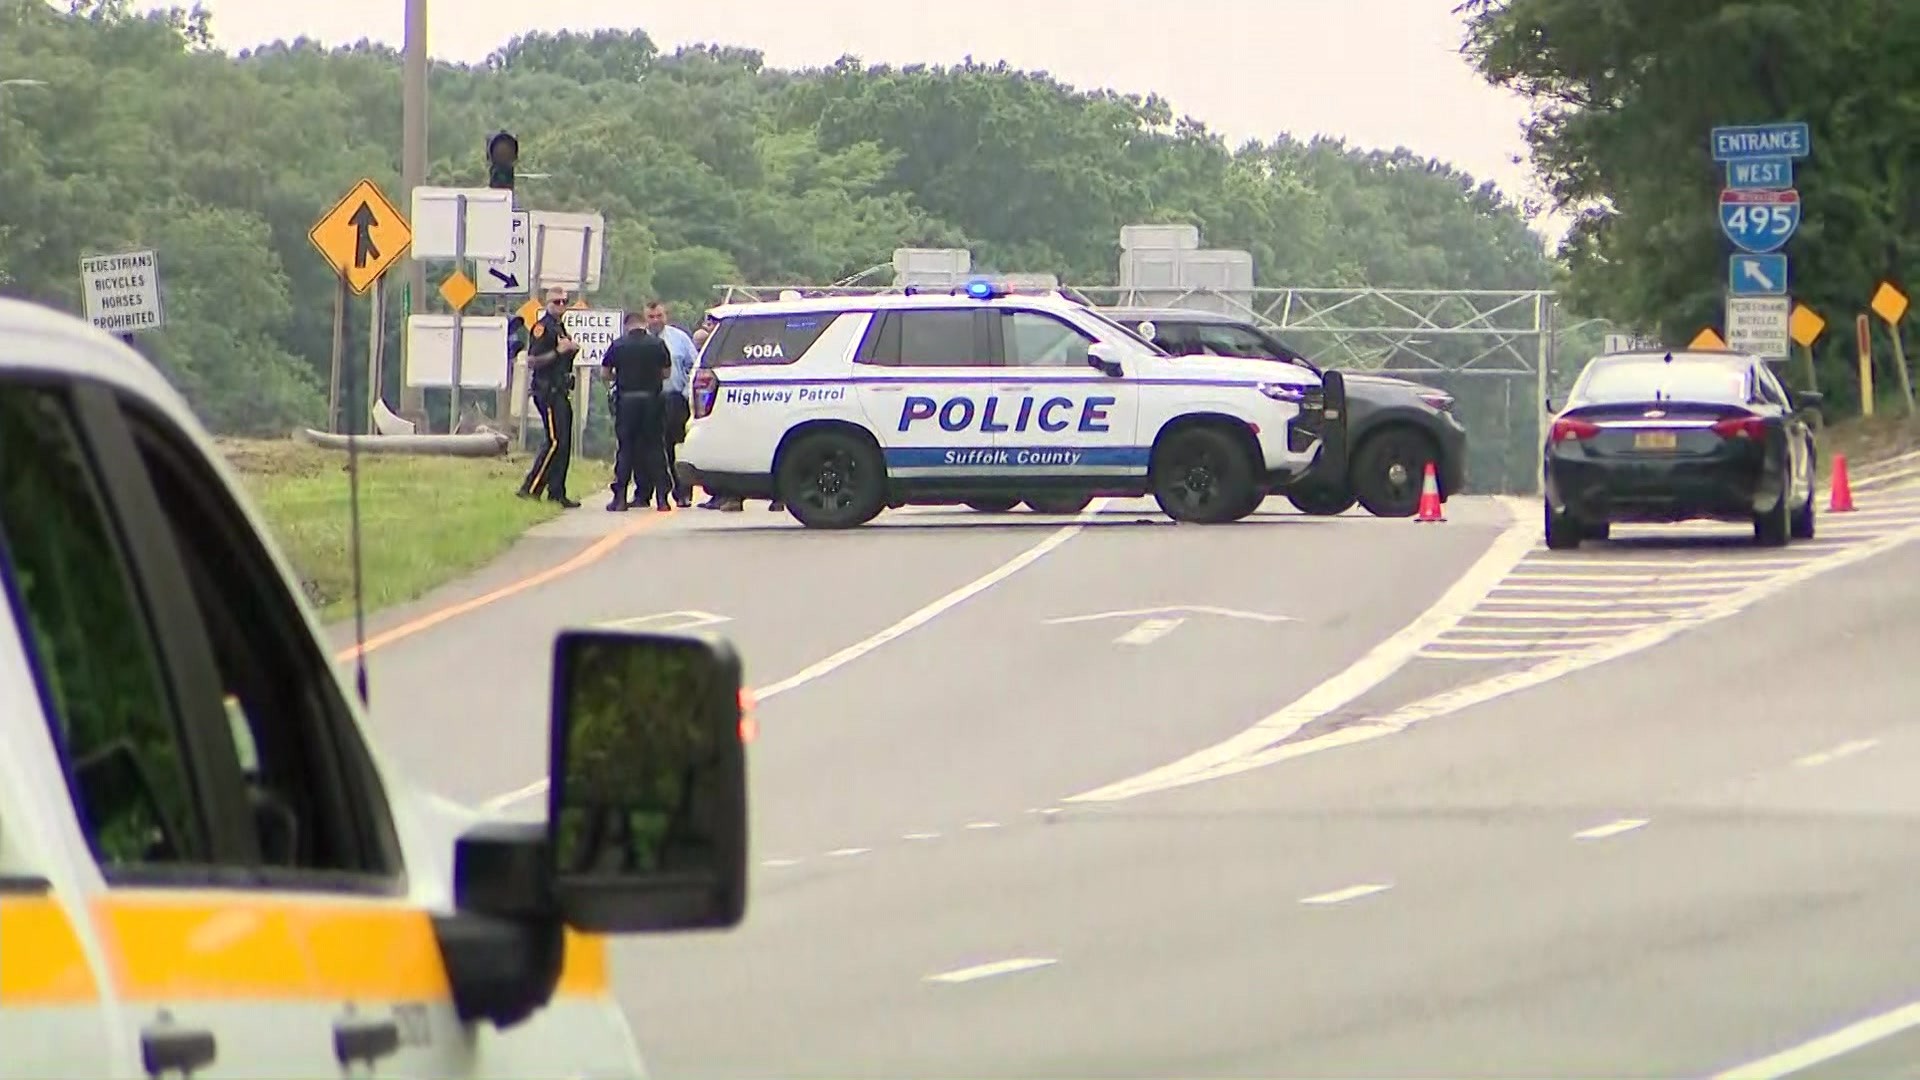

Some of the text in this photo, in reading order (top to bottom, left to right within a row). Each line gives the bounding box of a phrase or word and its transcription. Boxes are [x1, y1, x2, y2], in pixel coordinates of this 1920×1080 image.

[1718, 131, 1801, 153] ENTRANCE
[1736, 163, 1783, 182] WEST
[1727, 206, 1792, 235] 495
[83, 255, 152, 273] PEDESTRIANS
[95, 275, 145, 291] BICYCLES
[101, 294, 143, 310] HORSES
[93, 311, 155, 329] PROHIBITED
[573, 332, 614, 344] GREEN
[582, 349, 606, 360] LAN
[743, 345, 783, 358] 908A
[727, 388, 845, 405] Highway Patrol
[898, 396, 1116, 432] POLICE
[944, 450, 1081, 465] Suffolk County
